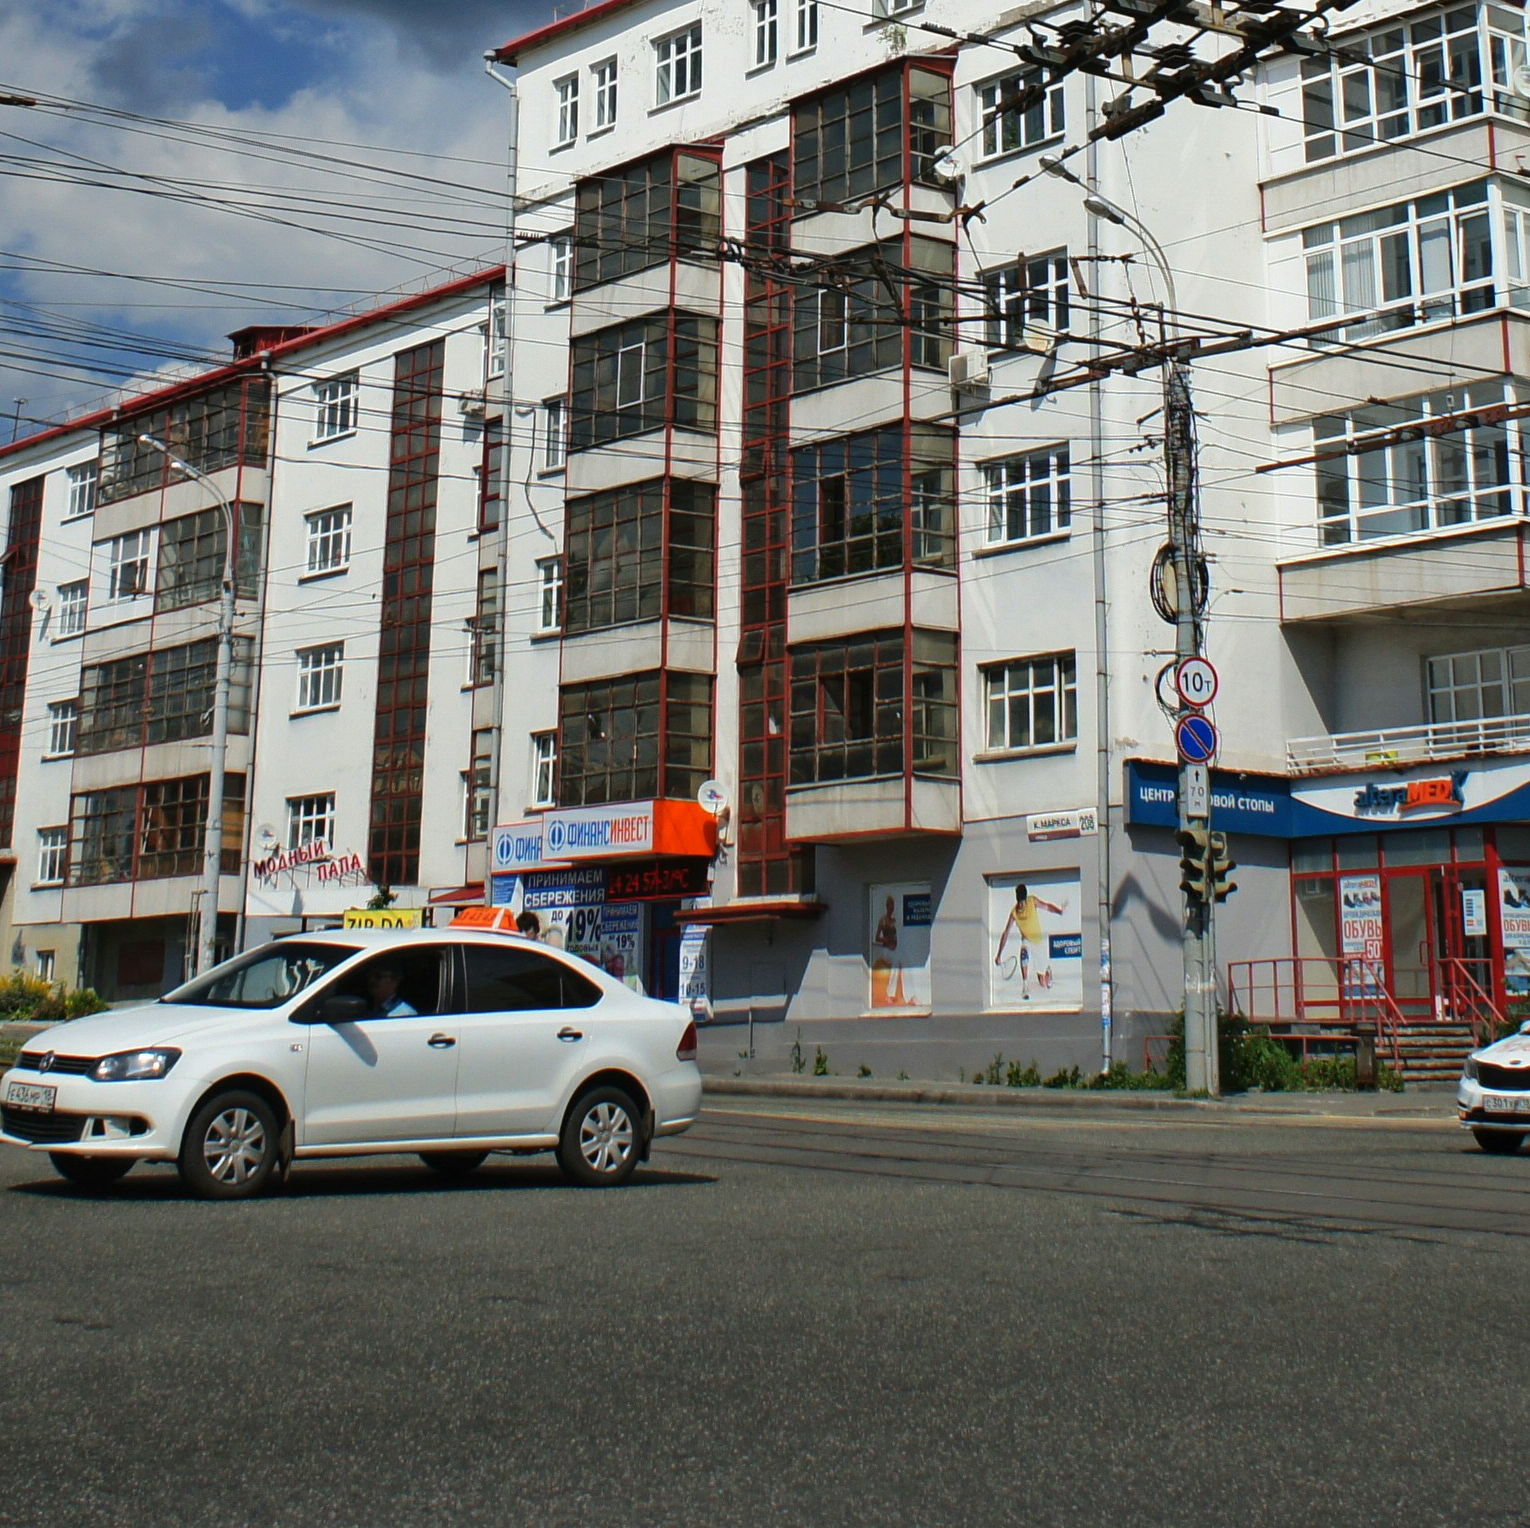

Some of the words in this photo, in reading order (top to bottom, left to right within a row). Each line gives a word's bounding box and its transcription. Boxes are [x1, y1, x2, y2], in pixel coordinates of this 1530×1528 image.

[1140, 787, 1175, 803] ЦЕНТР
[1238, 798, 1274, 813] СТОПЫ
[1190, 786, 1205, 797] 70
[567, 816, 650, 848] ФИНАНСИНВЕСТ
[254, 838, 325, 877] МОДНЫЙ
[317, 853, 362, 882] ПАПА
[528, 869, 603, 888] ПРИНИМАЕМ
[524, 888, 606, 908] СБЕРЕЖЕНИЯ
[565, 907, 602, 943] 19%
[1344, 919, 1382, 939] ОБУВЬ
